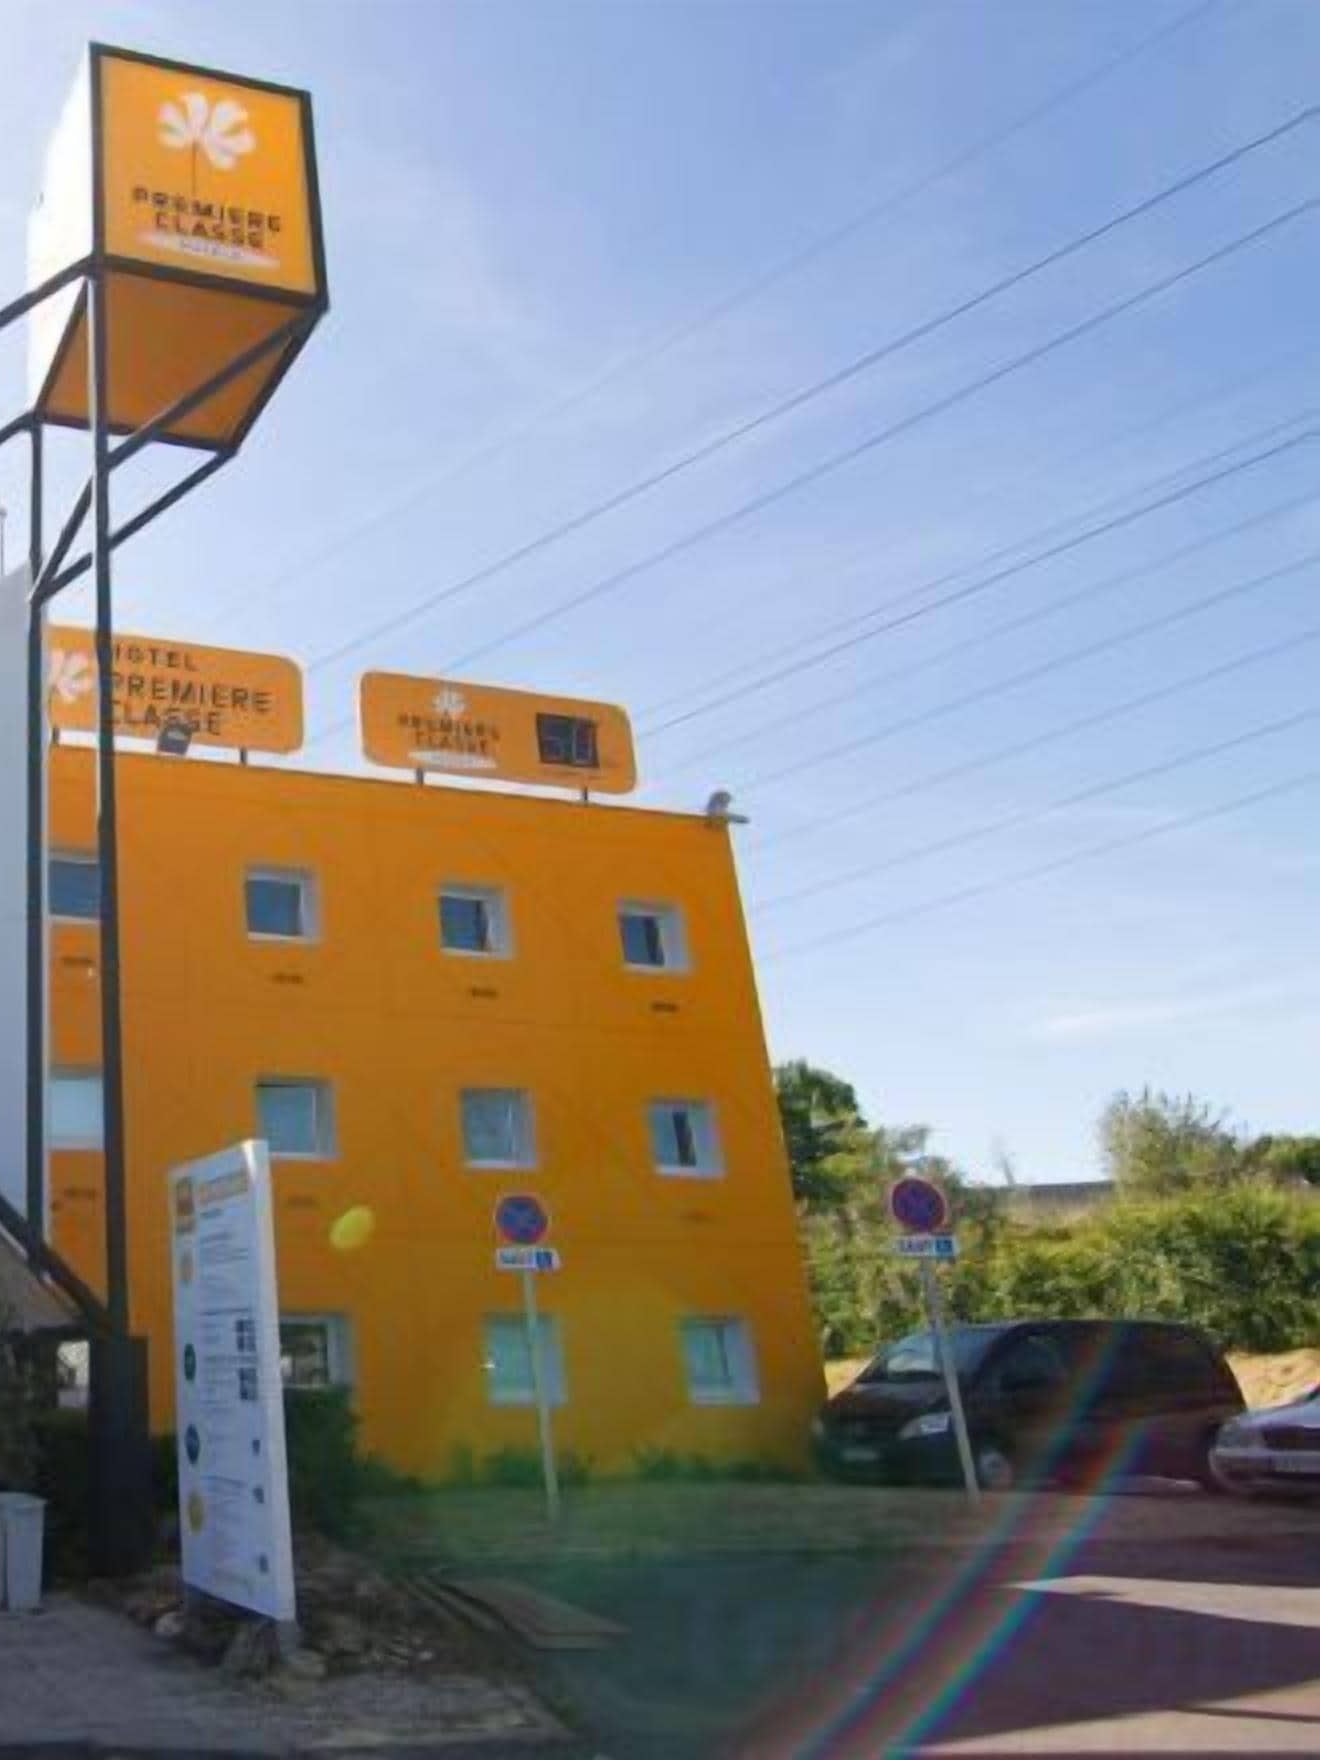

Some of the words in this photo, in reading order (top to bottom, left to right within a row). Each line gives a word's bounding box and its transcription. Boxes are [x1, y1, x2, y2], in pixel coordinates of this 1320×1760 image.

[134, 186, 281, 233] PREMIERE
[155, 211, 264, 249] CLASSE
[111, 672, 274, 713] PREMIERE
